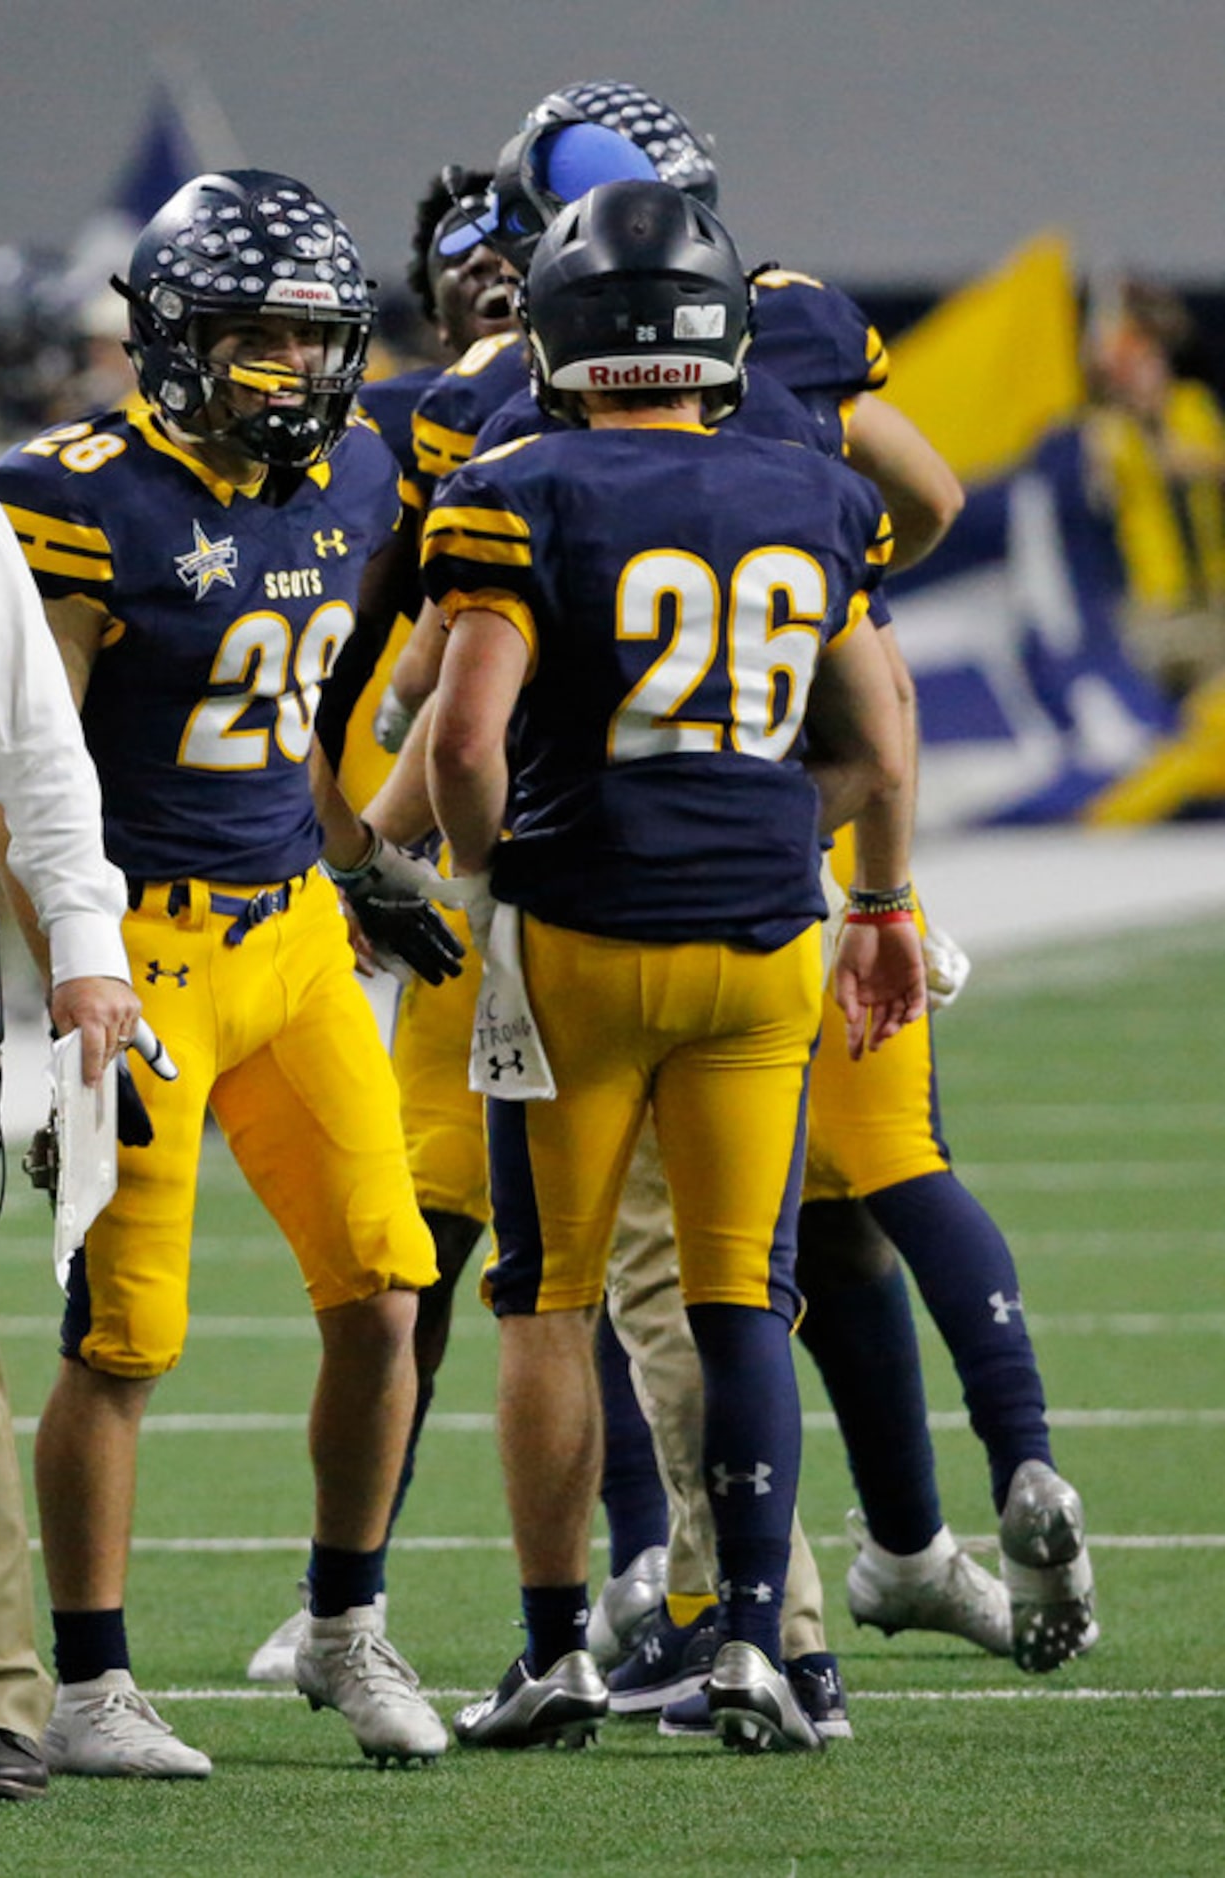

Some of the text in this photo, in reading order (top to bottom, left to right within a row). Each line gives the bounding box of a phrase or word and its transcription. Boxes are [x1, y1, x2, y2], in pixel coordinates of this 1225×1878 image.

[636, 325, 657, 342] 26
[588, 363, 702, 386] Riddell
[20, 421, 128, 473] 28
[264, 567, 323, 600] SCOTS
[606, 544, 828, 763] 26
[476, 1014, 533, 1052] TRONG
